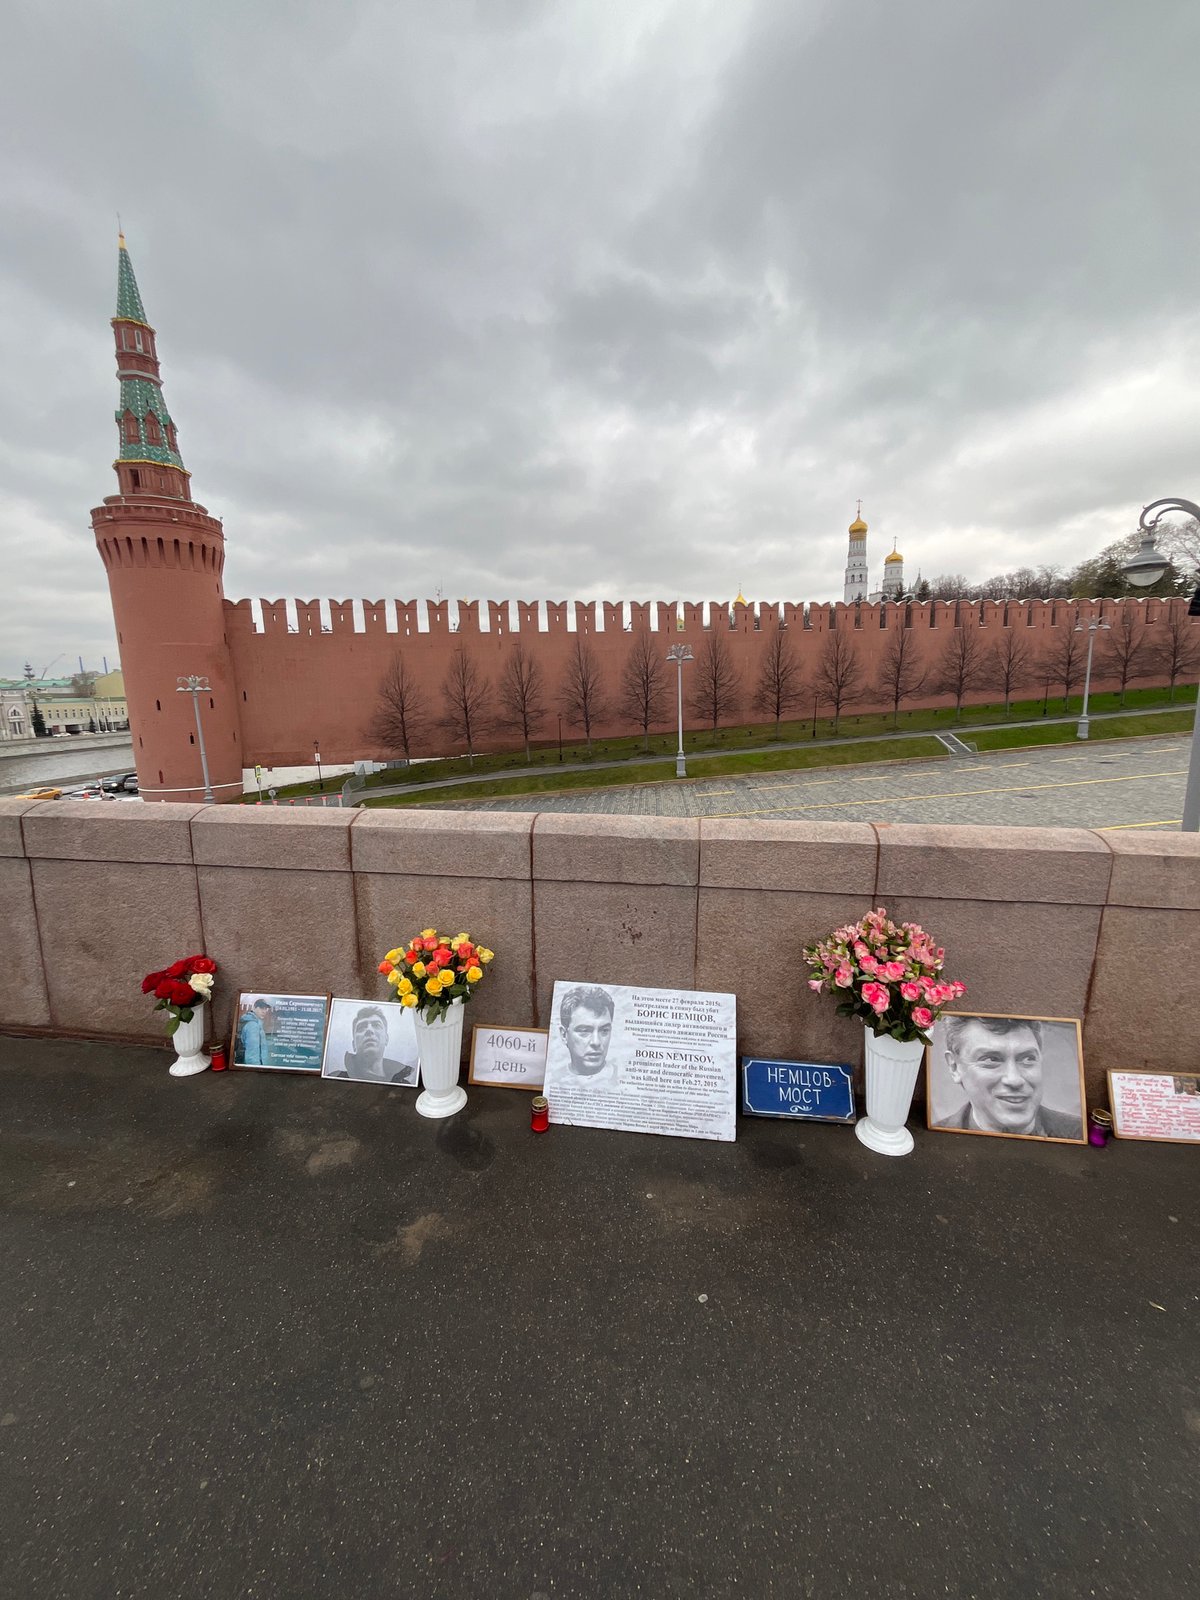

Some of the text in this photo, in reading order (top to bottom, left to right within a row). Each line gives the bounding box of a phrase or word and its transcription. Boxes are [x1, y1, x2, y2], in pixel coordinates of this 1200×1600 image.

[637, 1010, 716, 1023] БОРИС НЕМЦОВ,
[624, 1026, 676, 1035] демократического
[487, 1034, 536, 1052] 4060-й
[635, 1050, 715, 1064] BORIS NEMTSOV,
[492, 1060, 527, 1073] день
[768, 1067, 832, 1088] НЕМЦОВ
[780, 1087, 821, 1104] МОСТ
